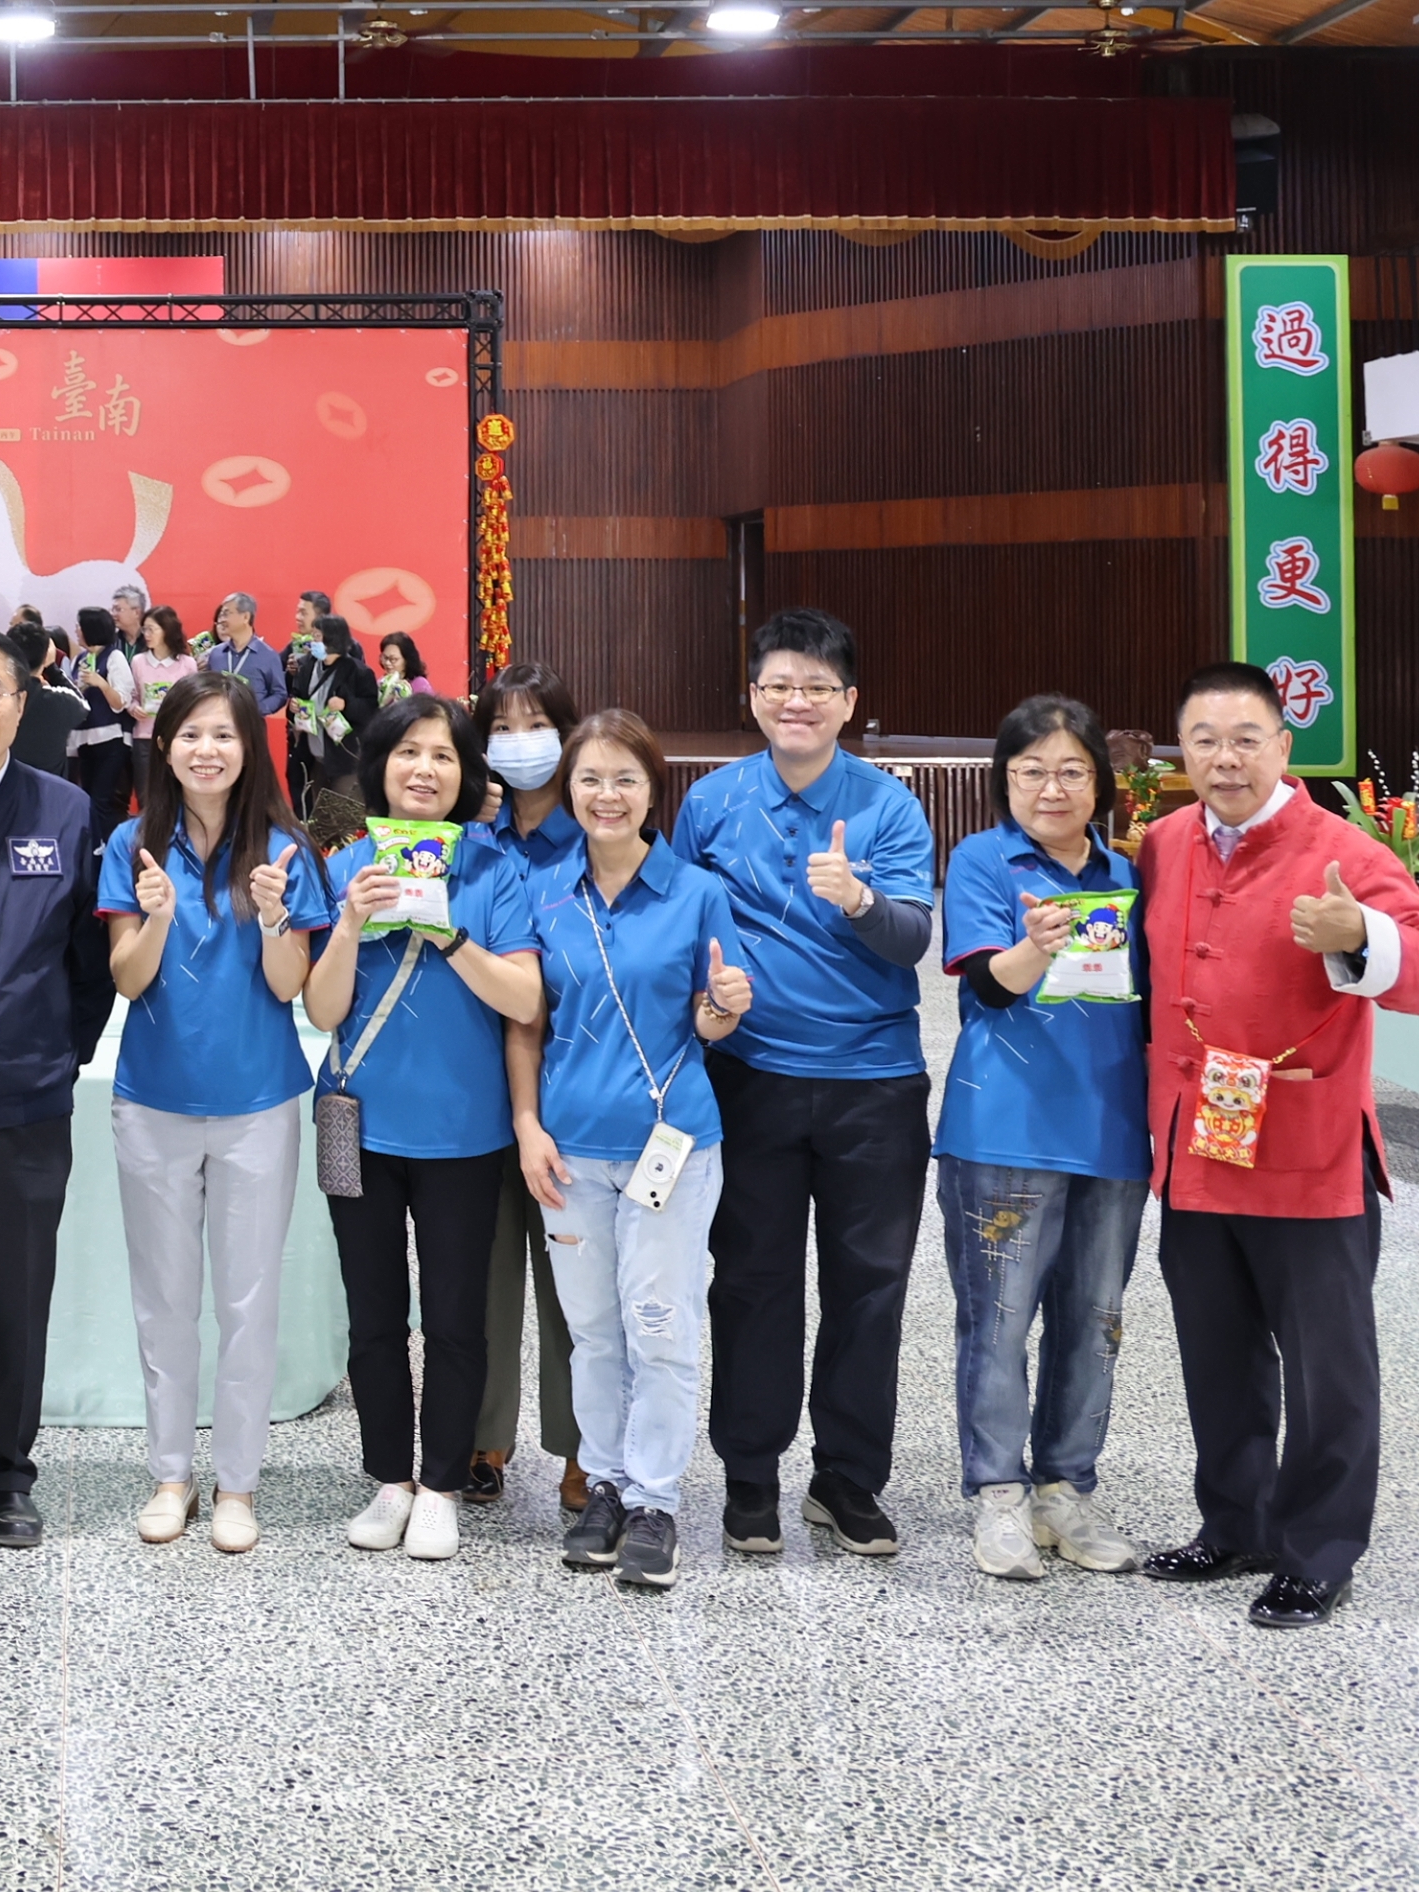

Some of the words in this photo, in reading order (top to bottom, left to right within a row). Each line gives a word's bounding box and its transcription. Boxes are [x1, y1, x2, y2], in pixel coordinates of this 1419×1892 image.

[29, 426, 96, 442] Tainan
[1255, 304, 1331, 727] 過得更好
